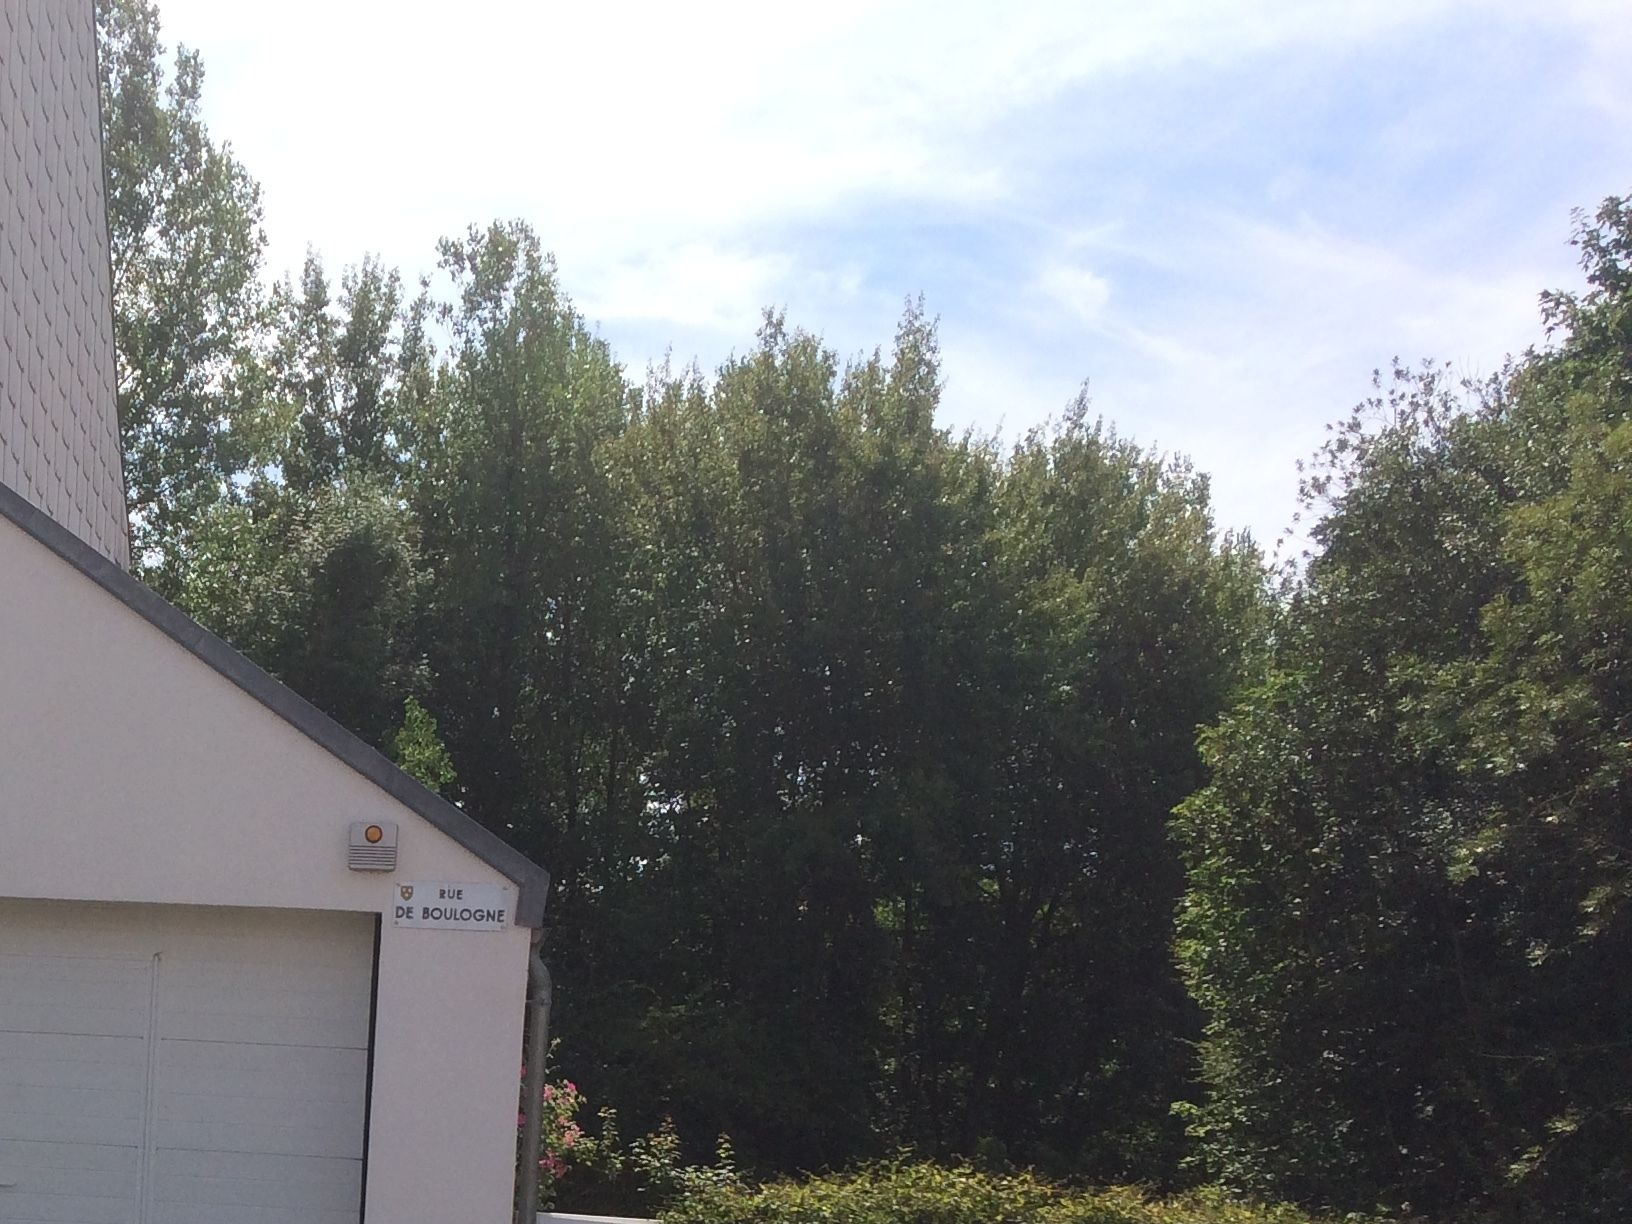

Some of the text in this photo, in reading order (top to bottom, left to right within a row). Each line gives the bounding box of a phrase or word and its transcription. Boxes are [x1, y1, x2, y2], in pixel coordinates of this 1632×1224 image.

[439, 888, 464, 900] RUE
[395, 906, 506, 923] DE BOULOGNE
